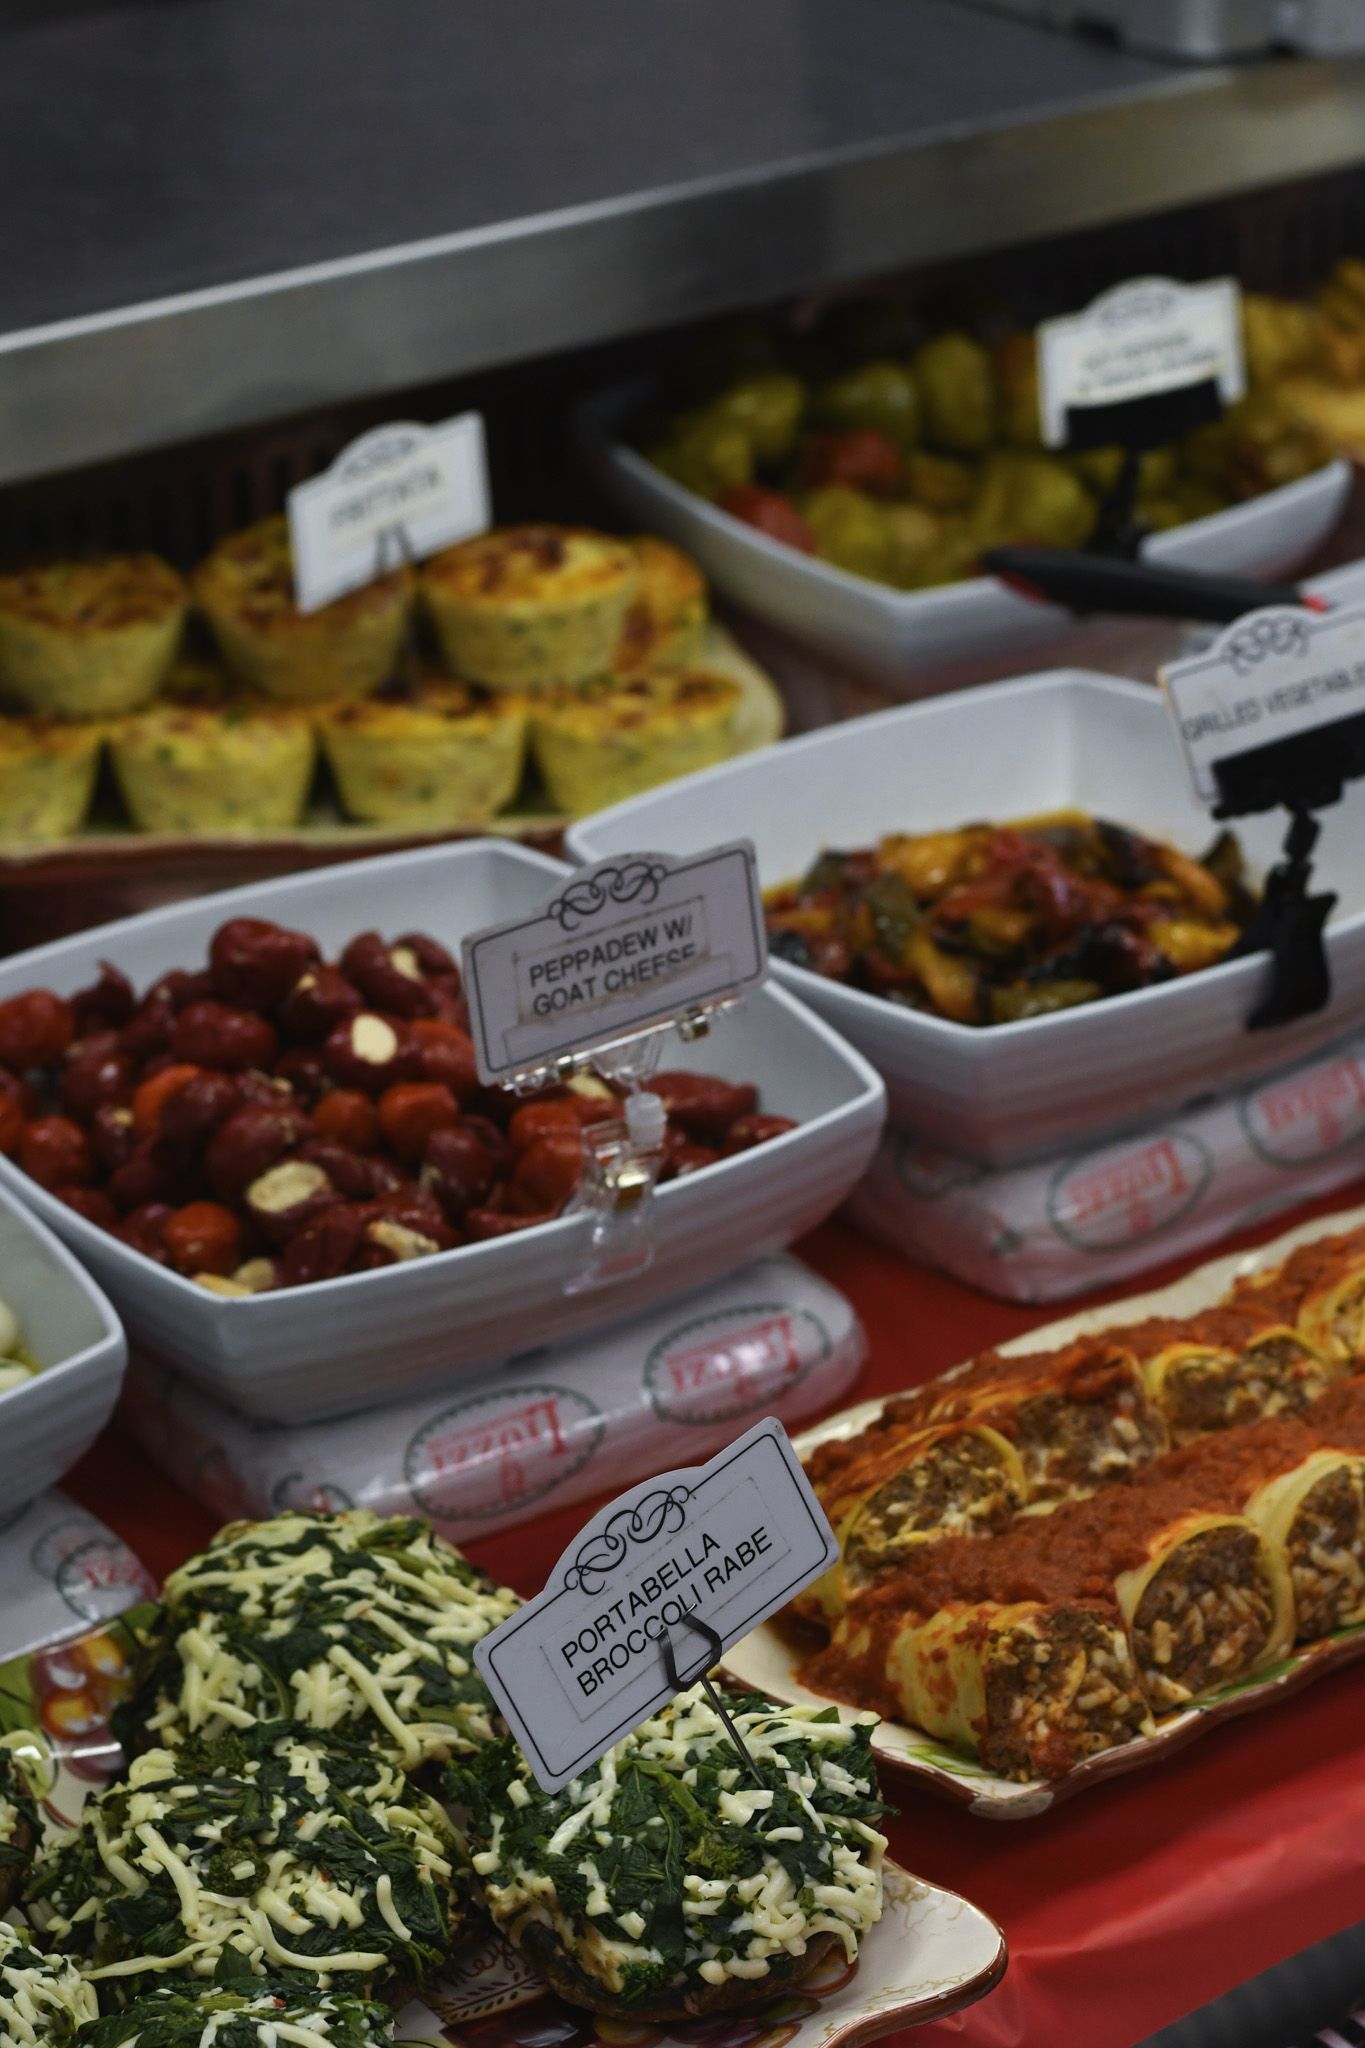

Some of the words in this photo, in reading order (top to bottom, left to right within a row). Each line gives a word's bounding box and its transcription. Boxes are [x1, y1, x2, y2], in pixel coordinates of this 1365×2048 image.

[530, 927, 658, 988] PEPPADEW
[664, 914, 694, 944] W/
[533, 977, 598, 1016] GOAT
[604, 943, 696, 993] CHEESE
[561, 1533, 721, 1669] PORTABELLA
[576, 1583, 703, 1698] BROCCOLI
[706, 1526, 773, 1595] RABE
